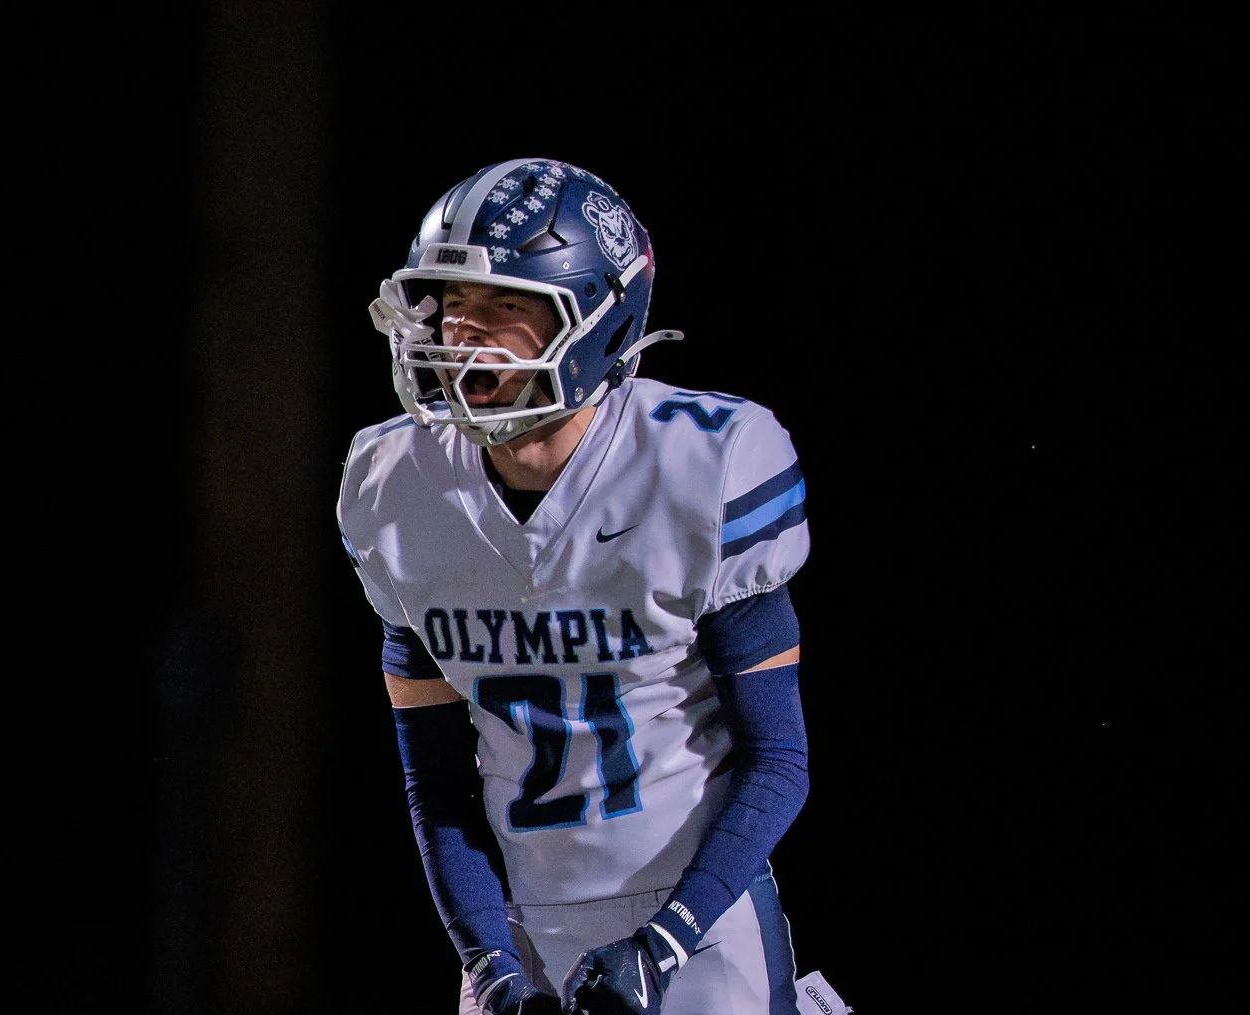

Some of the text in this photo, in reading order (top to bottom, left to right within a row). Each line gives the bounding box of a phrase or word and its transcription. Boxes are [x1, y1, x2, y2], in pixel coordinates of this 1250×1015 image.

[424, 608, 654, 664] OLYMPIA
[472, 672, 644, 833] 21
[668, 900, 695, 926] NXTRND
